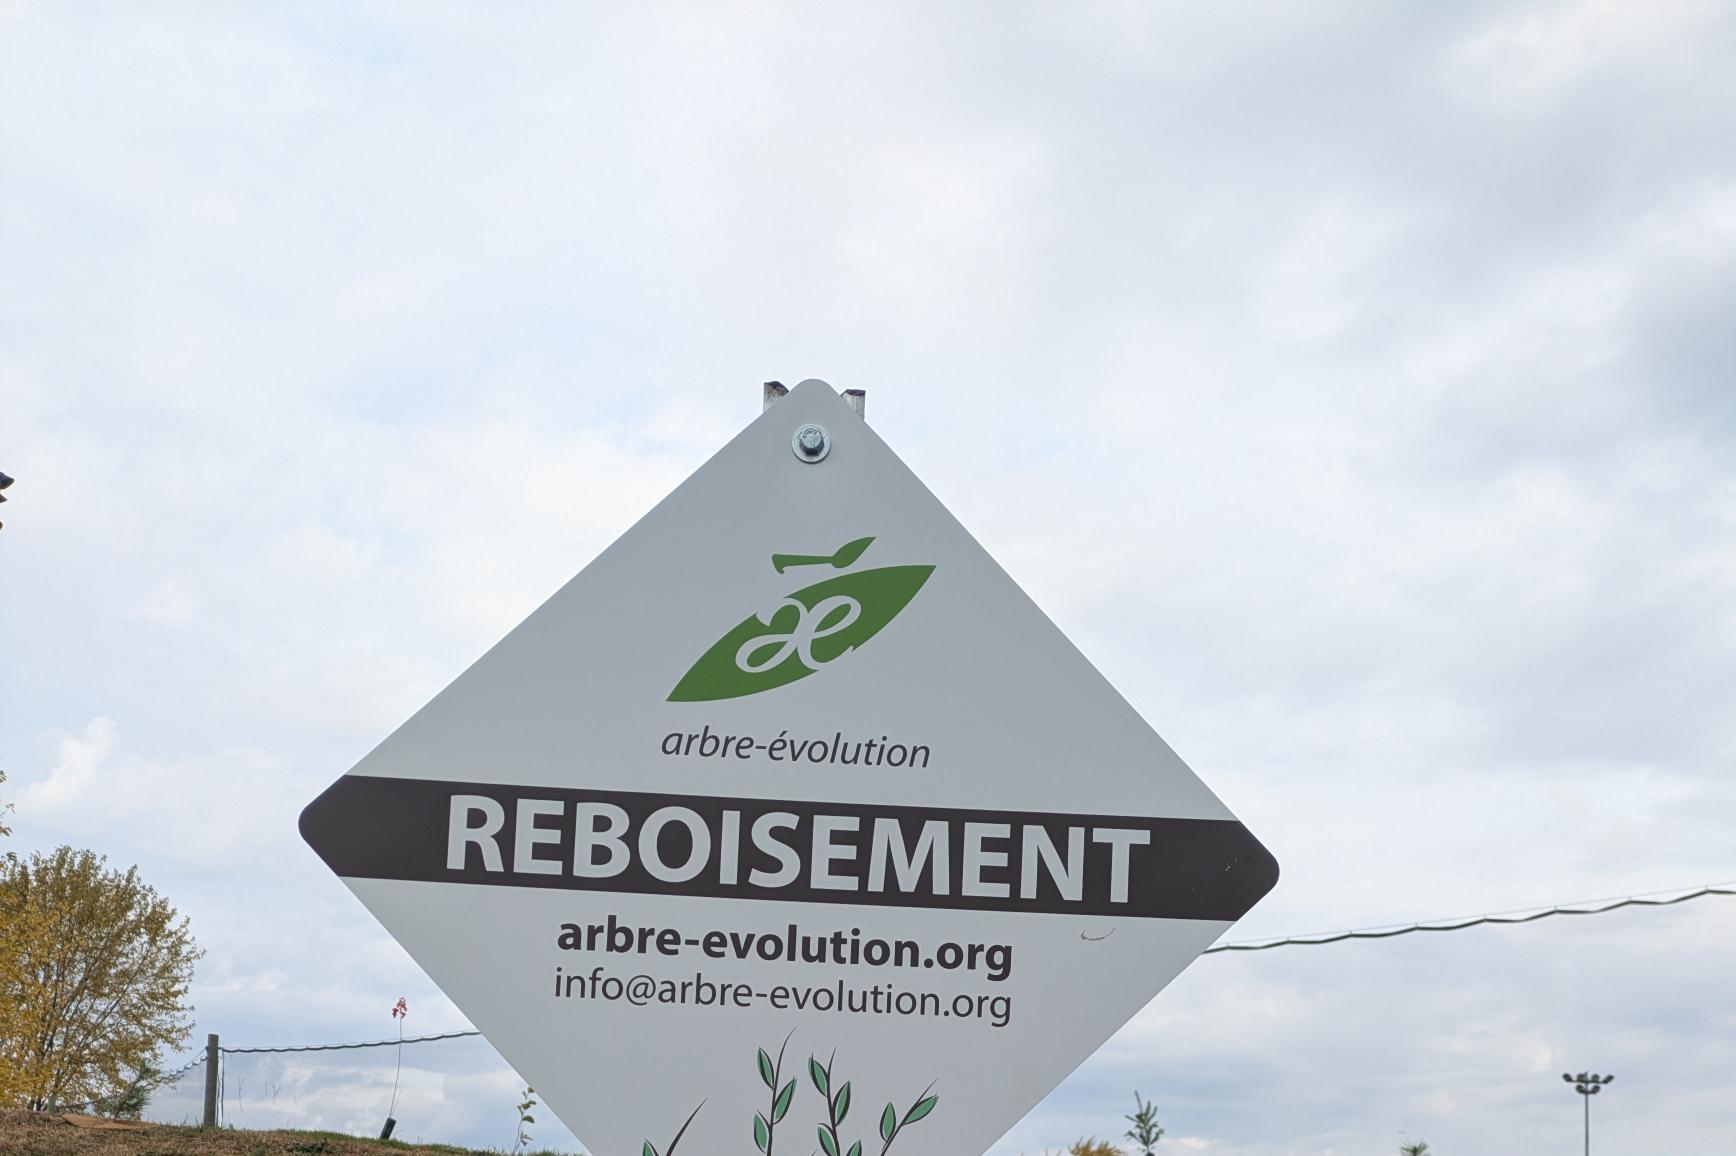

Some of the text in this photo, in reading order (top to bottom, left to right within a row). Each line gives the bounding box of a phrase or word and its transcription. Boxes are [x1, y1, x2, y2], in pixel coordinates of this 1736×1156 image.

[661, 725, 931, 768] arbre-évolution
[446, 794, 1151, 904] REBOISEMENT
[557, 914, 1013, 982] arbre-evolution.org
[554, 966, 1012, 1028] info@arbre-evolution.org
